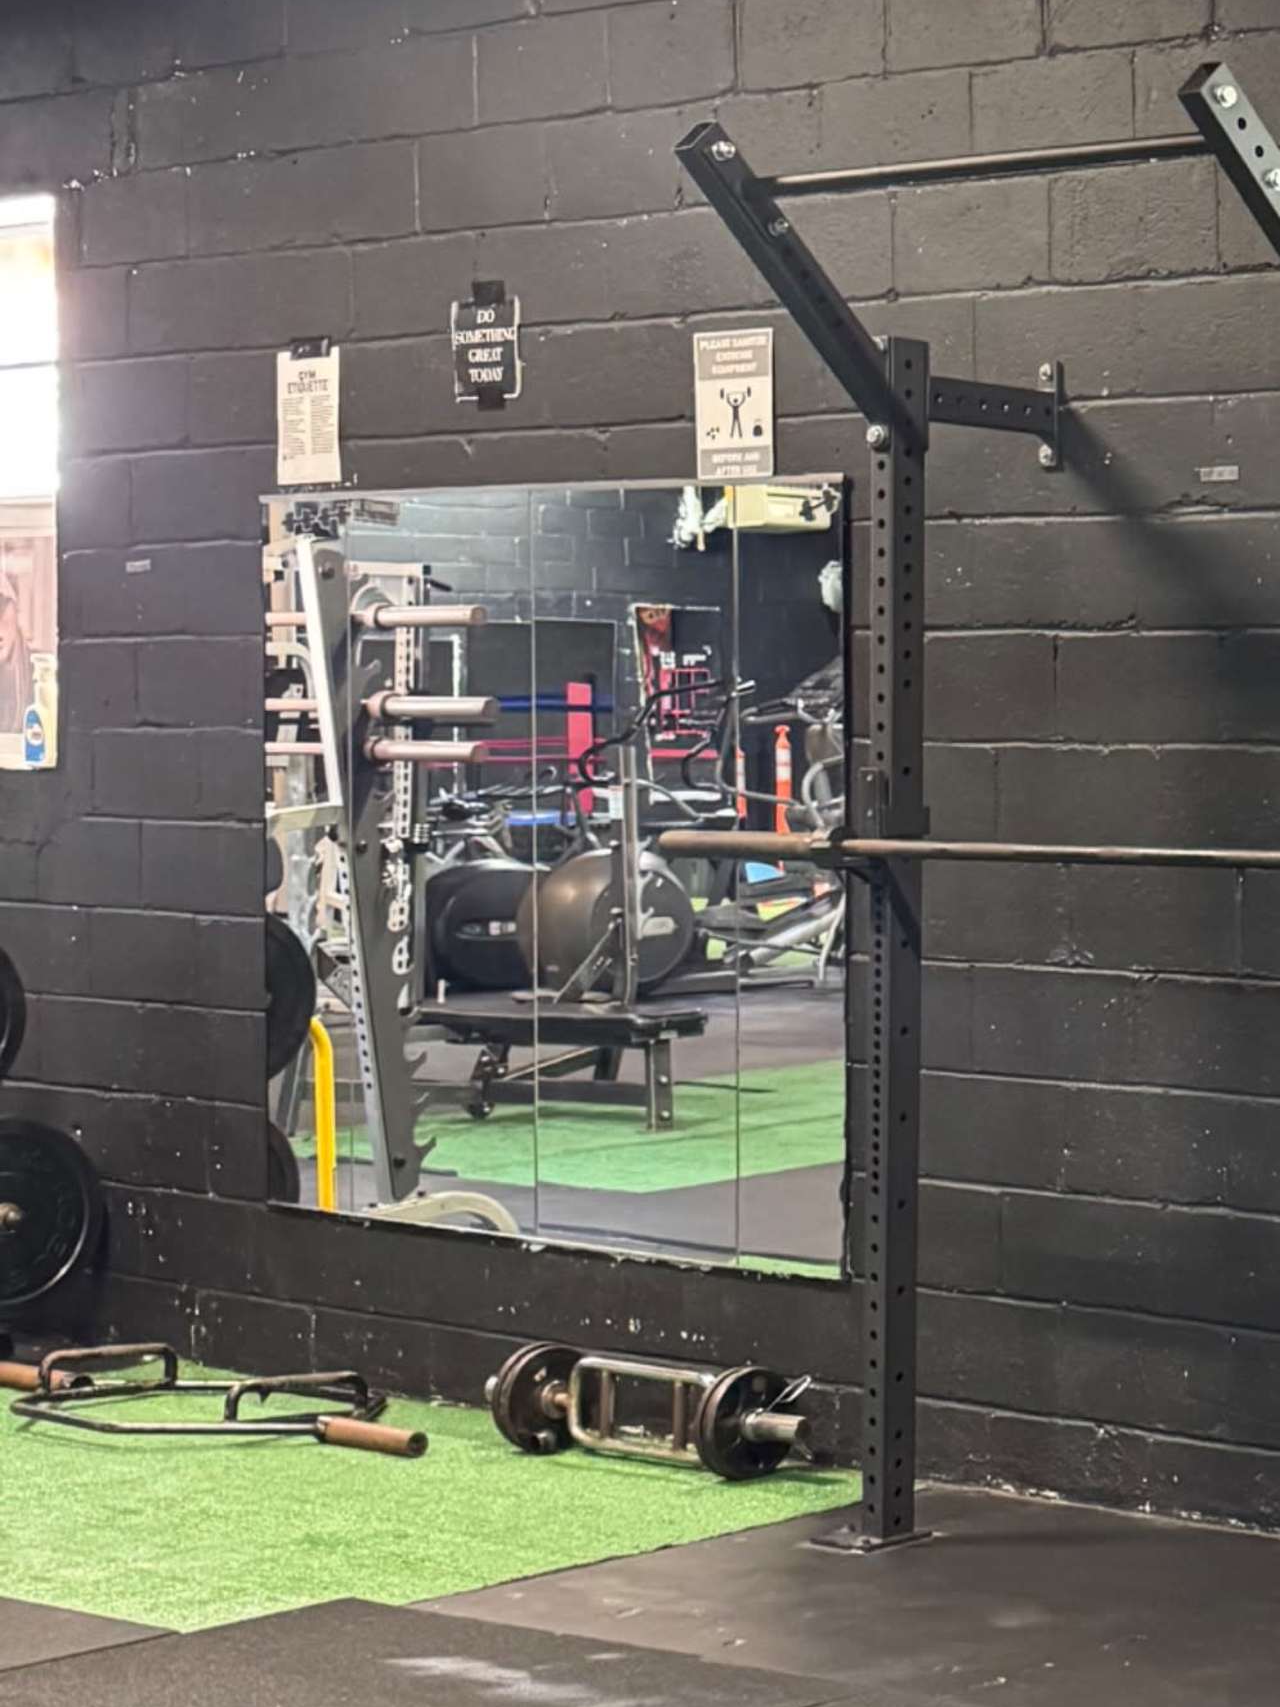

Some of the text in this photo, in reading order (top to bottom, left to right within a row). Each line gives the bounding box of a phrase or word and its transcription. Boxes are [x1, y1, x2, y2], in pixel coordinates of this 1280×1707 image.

[476, 309, 496, 323] DO
[468, 347, 503, 363] GREAT
[468, 367, 504, 383] TODAY
